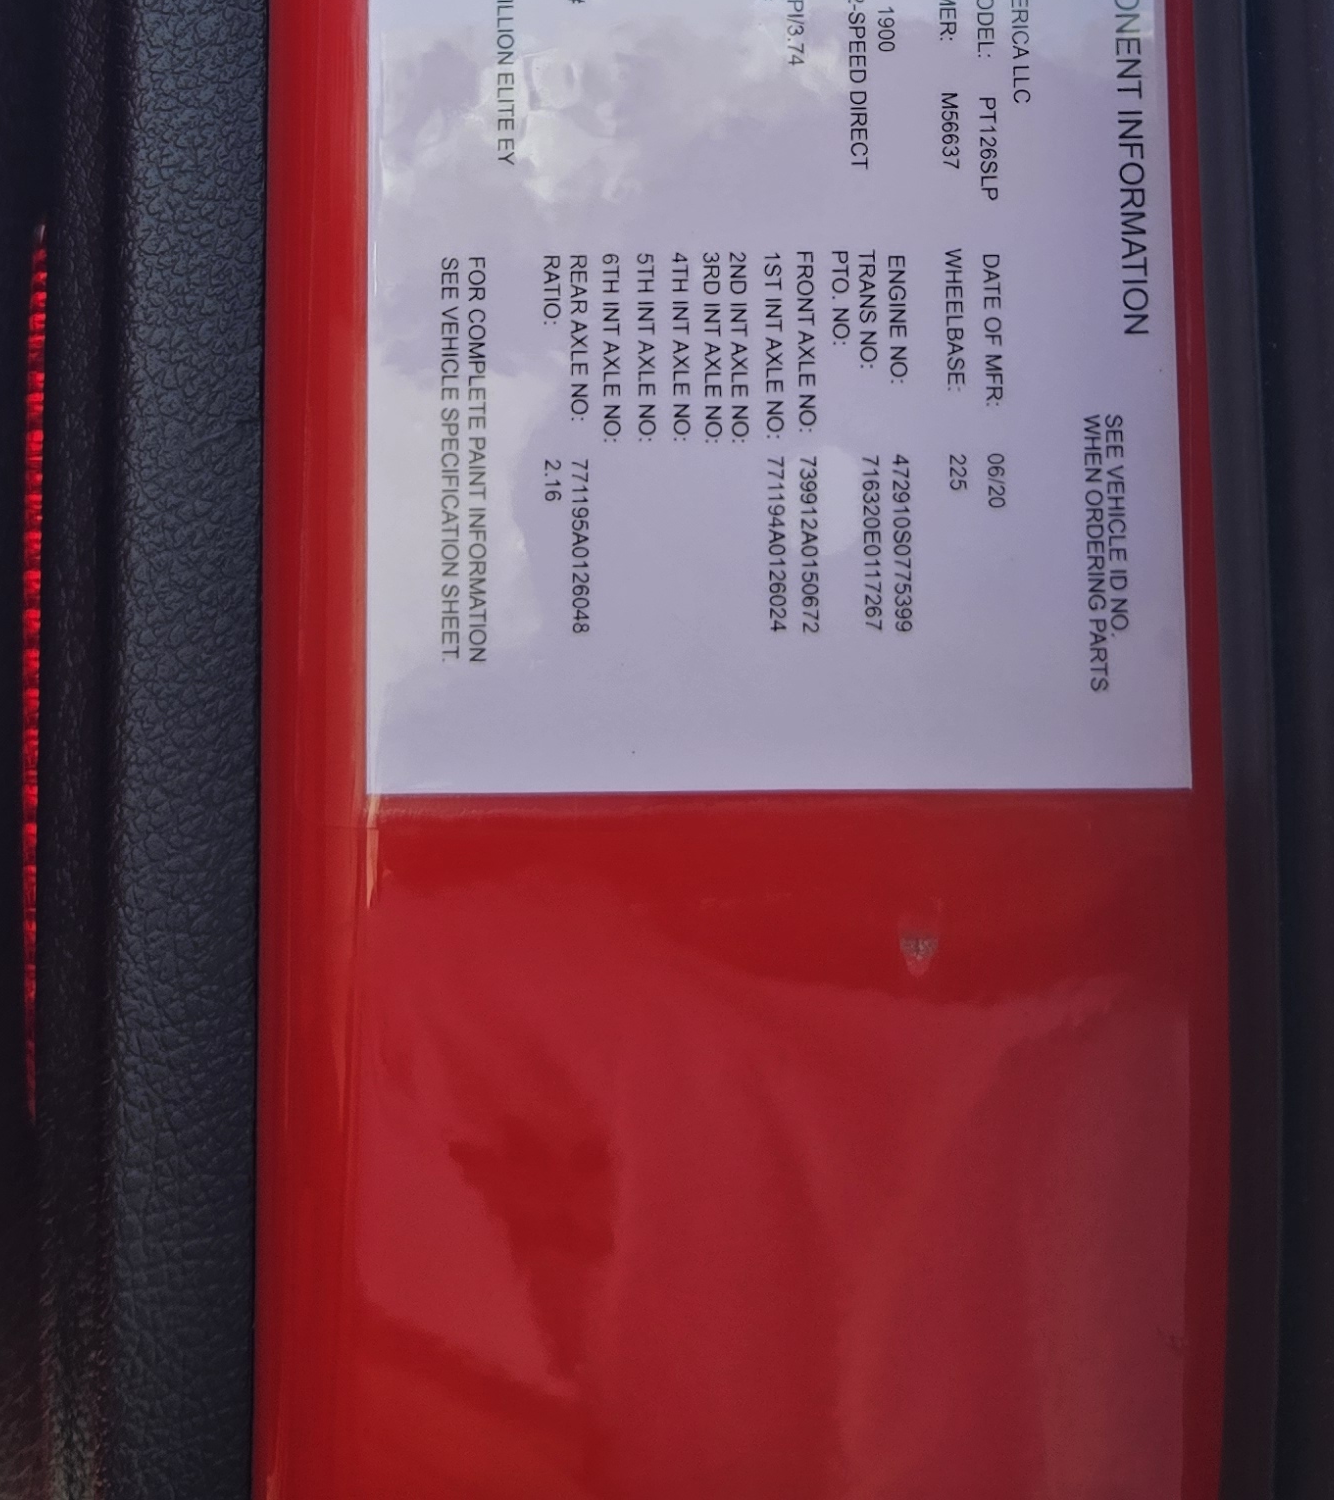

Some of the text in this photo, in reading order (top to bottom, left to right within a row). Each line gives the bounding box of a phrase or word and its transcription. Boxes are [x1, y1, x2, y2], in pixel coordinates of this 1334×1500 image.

[496, 72, 515, 131] ELITE
[849, 90, 869, 170] DIRECT
[877, 6, 896, 52] 1900
[940, 92, 961, 170] M56637
[1012, 65, 1032, 104] LLC
[497, 137, 515, 166] EY
[978, 97, 999, 202] PT126SLP
[1117, 110, 1150, 335] INFORMATION
[543, 255, 563, 502] RATIO: 2.16
[671, 251, 692, 442] 4TH INT AXLE NO:
[702, 252, 723, 444] 3RD INT AXLE NO:
[728, 251, 750, 444] 2ND INT AXLE NO:
[831, 250, 851, 346] PTO. NO:
[944, 247, 968, 491] WHEELBASE: 225
[982, 254, 1006, 509] DATE OF MFR: 06/20
[440, 256, 460, 662] SEE VEHICLE SPECIFICATION SHEET.
[467, 256, 488, 663] FOR COMPLETE PAINT INFORMATION
[569, 254, 591, 634] REAR AXLE NO: 771195A0126048
[763, 252, 787, 633] 1ST INT AXLE NO: 771194A0126024
[796, 251, 820, 634] FRONT AXLE NO: 739912A0150672
[858, 248, 883, 632] TRANS NO: 716320E0117267
[887, 255, 913, 633] ENGINE NO: 472910S0775399
[1104, 413, 1130, 637] SEE VEHICLE ID NO.
[1083, 413, 1110, 693] WHEN ORDERING PARTS
